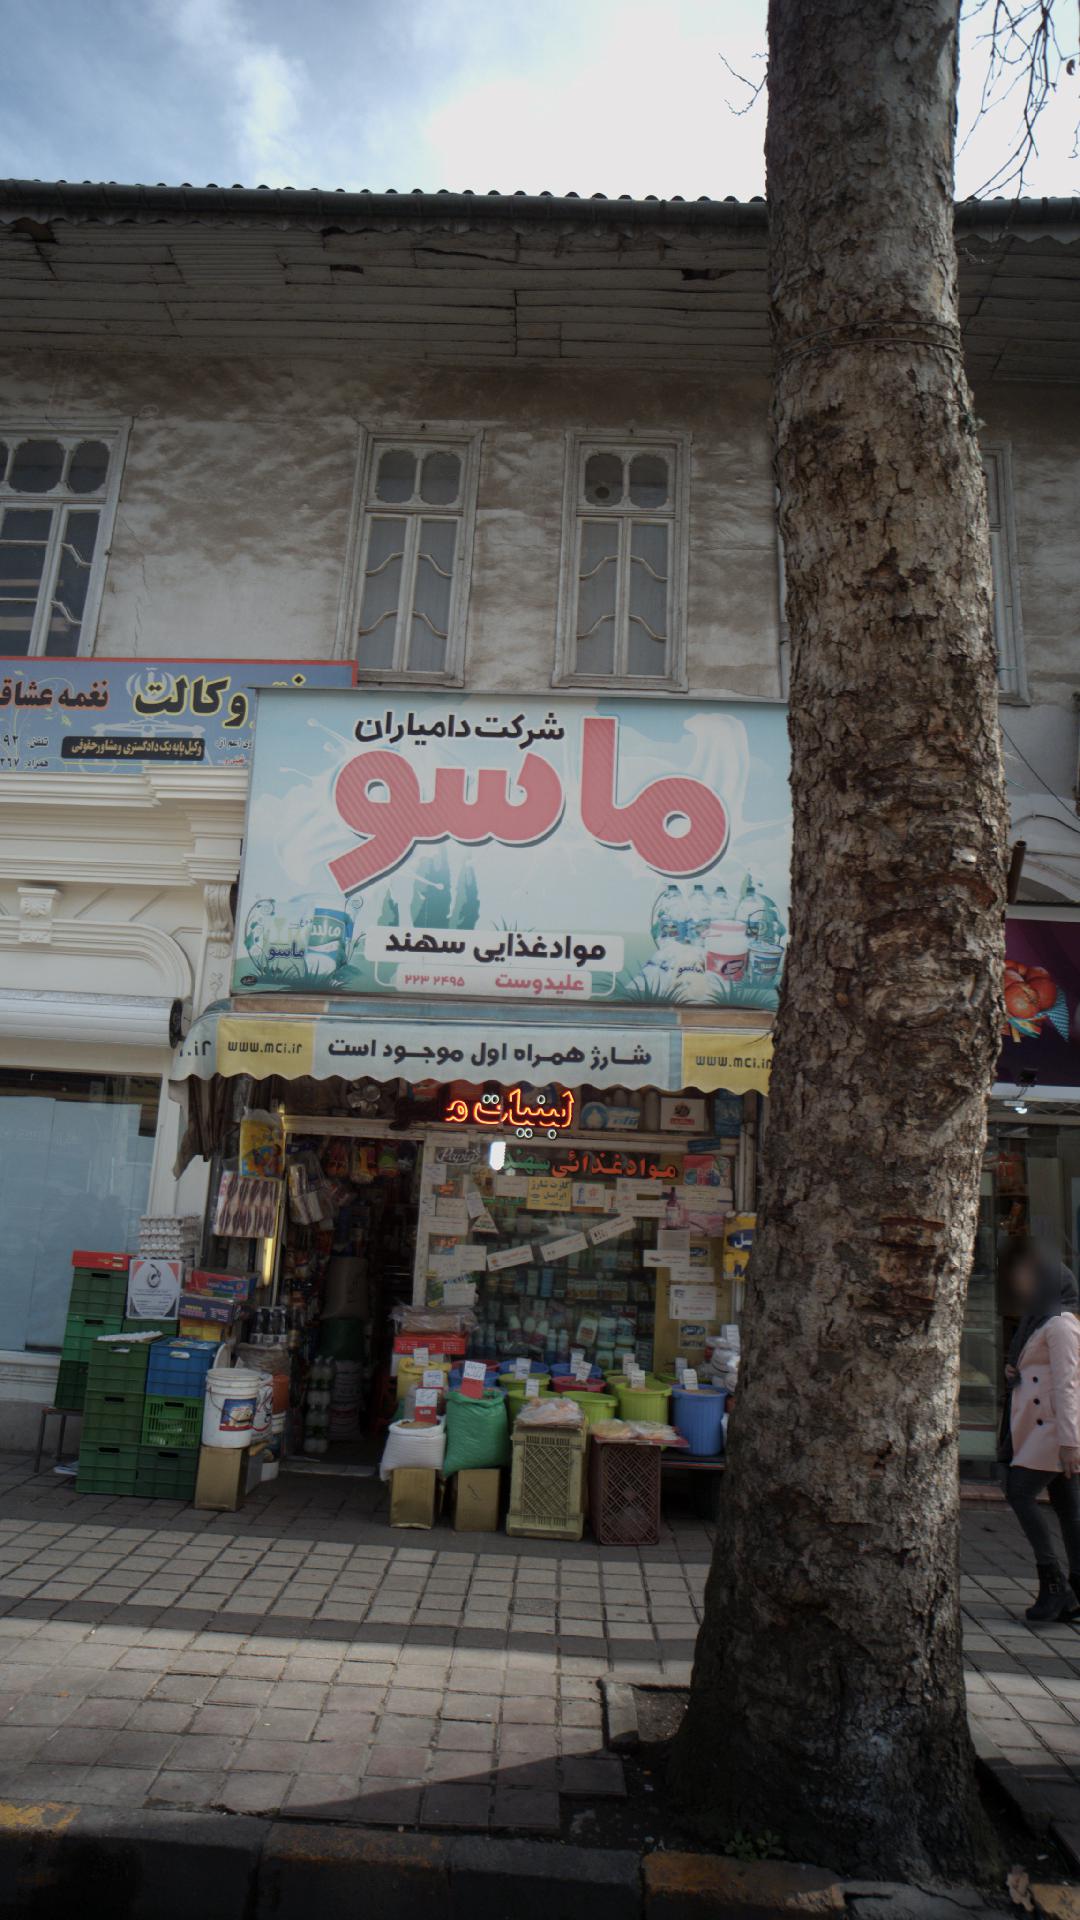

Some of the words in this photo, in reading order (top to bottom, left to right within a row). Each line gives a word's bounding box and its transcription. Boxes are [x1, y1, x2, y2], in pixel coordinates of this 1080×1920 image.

[0, 678, 53, 707] عشاق
[58, 679, 109, 708] نغمه
[134, 675, 249, 729] وکالت
[355, 711, 471, 746] دامیاران
[475, 712, 565, 750] شرکت
[328, 716, 728, 892] ماسو
[385, 932, 466, 953] سهند
[495, 972, 585, 995] علیدوست
[228, 1041, 302, 1054] www.mci.ir
[328, 1039, 376, 1057] است
[383, 1043, 464, 1065] موجود
[471, 1042, 507, 1066] اول
[514, 1043, 585, 1067] همراه
[590, 1045, 652, 1069] شارژ
[473, 1088, 575, 1140] لبنیات
